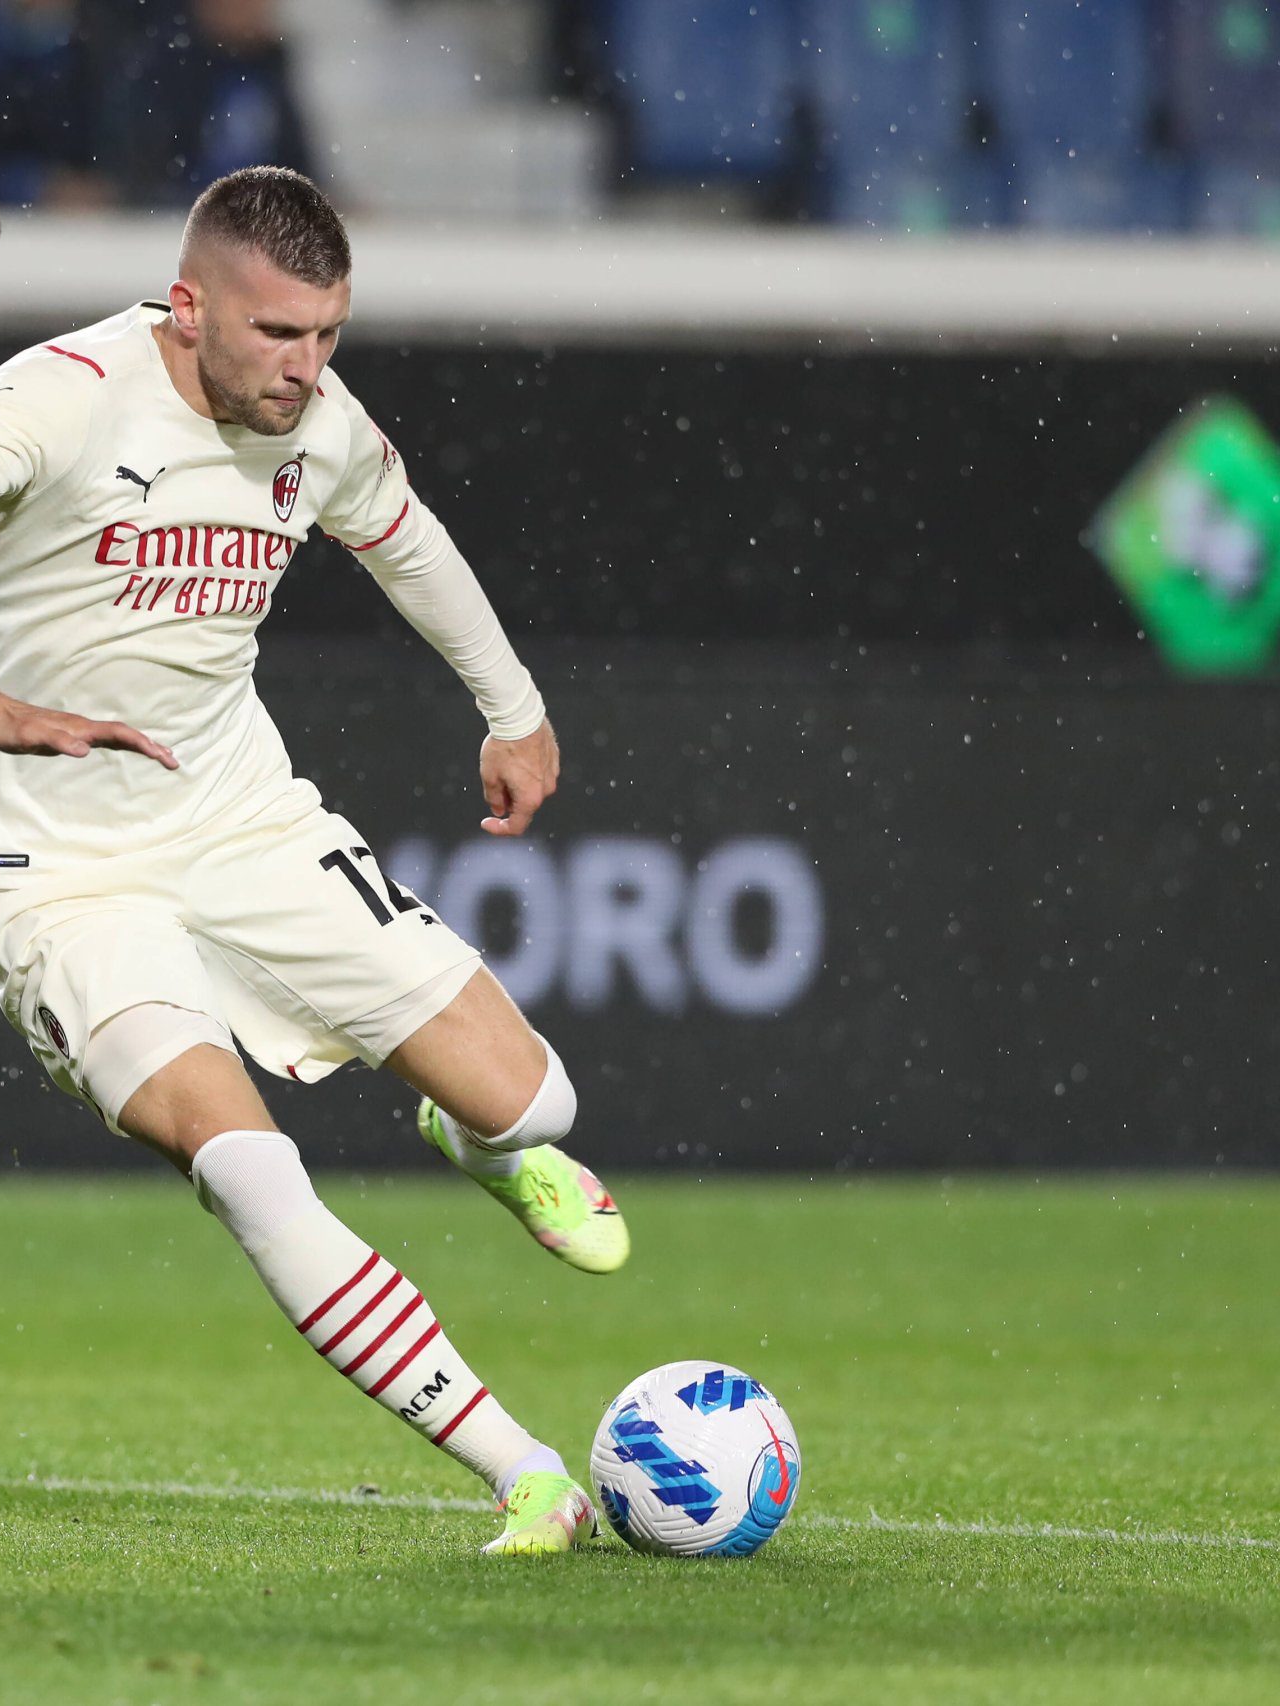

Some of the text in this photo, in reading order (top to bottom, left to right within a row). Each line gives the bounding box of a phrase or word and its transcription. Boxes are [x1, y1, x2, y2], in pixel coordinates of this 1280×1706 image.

[113, 574, 268, 617] FLY BETTER
[399, 1368, 452, 1422] ACM
